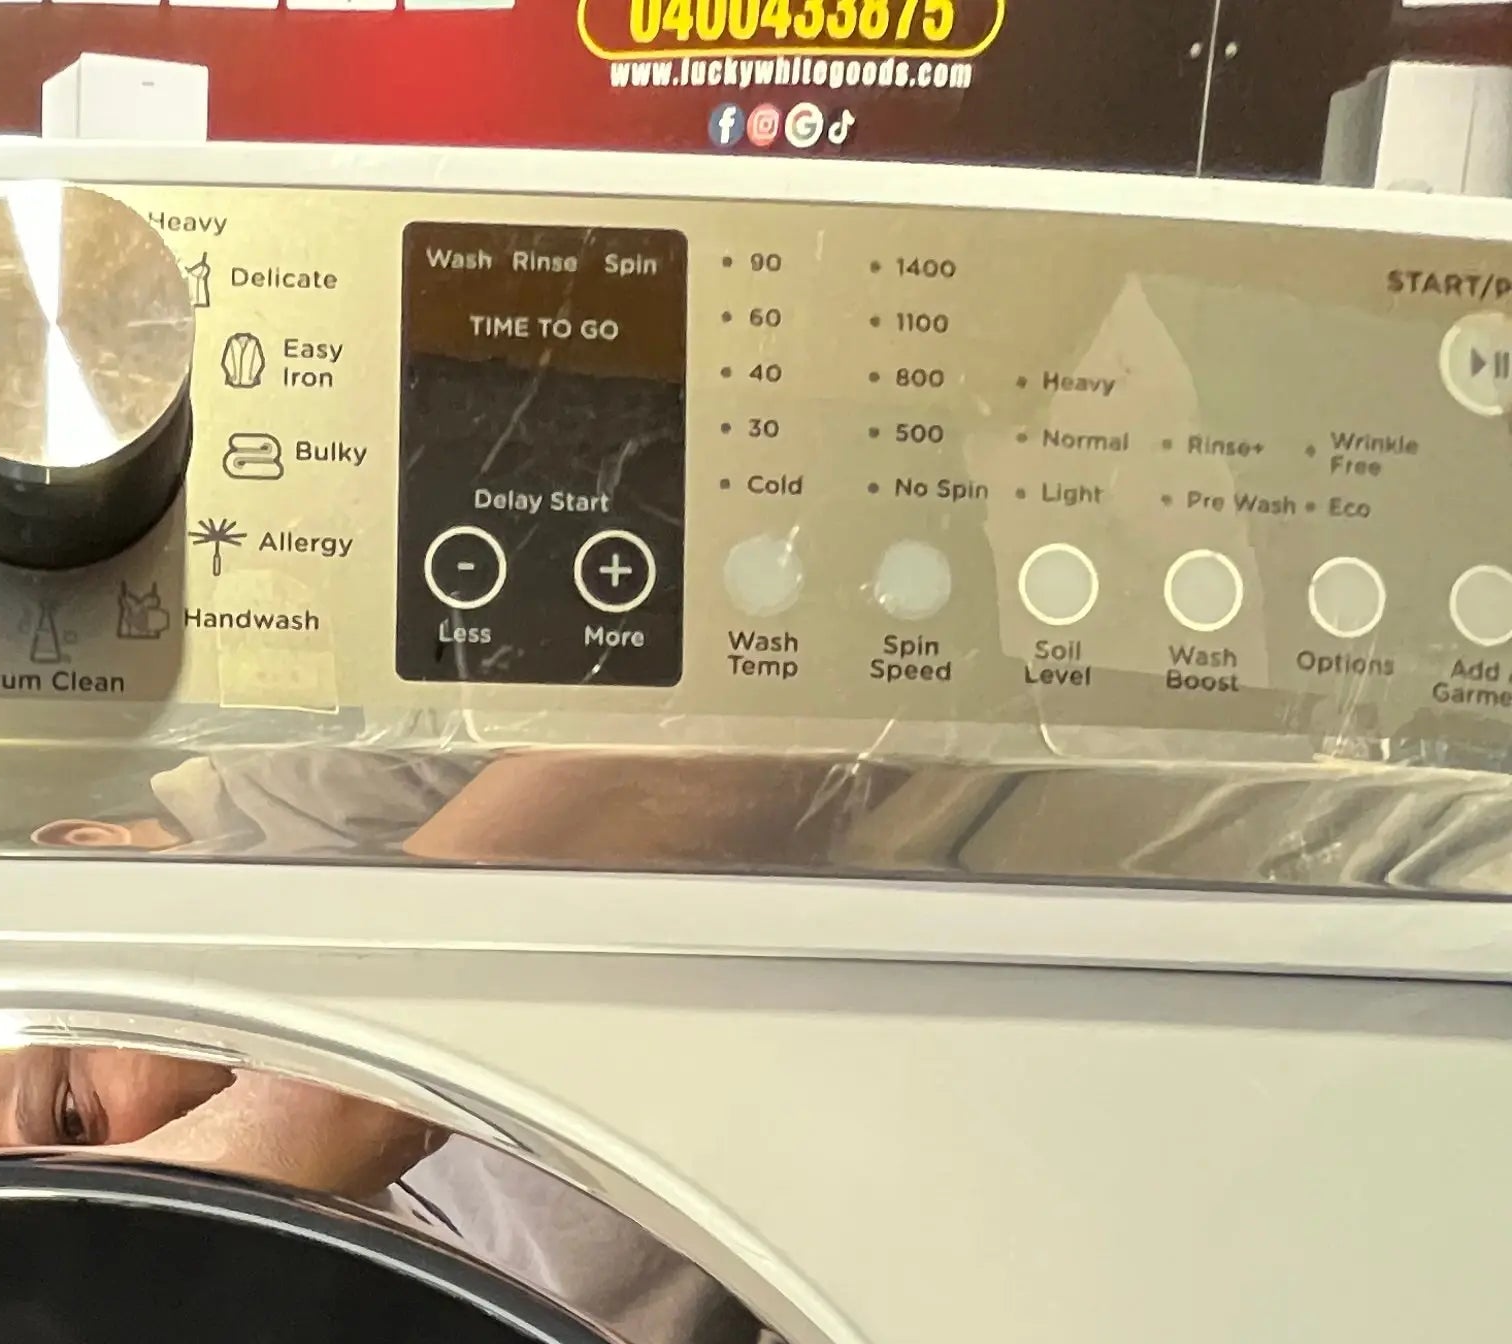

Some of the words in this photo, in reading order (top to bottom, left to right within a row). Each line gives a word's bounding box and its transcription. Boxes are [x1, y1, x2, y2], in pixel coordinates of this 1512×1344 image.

[610, 57, 974, 89] www.luckywhitegoods.com
[149, 212, 228, 236] Heavy
[426, 248, 493, 269] Wash
[512, 251, 579, 273] Rinse
[604, 253, 658, 278] Spin
[749, 252, 783, 273] 90
[895, 256, 957, 279] 1400
[231, 267, 338, 290] Delicate
[469, 314, 530, 339] TIME
[538, 318, 573, 339] TO
[580, 319, 620, 341] GO
[748, 307, 782, 328] 60
[895, 311, 950, 334] 1100
[284, 337, 344, 363] Easy
[283, 366, 334, 388] Iron
[748, 363, 783, 383] 40
[895, 367, 945, 388] 800
[1042, 370, 1117, 397] Heavy
[748, 418, 781, 439] 30
[895, 423, 945, 444] 500
[1041, 428, 1130, 452] Normal
[295, 440, 368, 467] Bulky
[1187, 434, 1265, 458] Rinse+
[1330, 430, 1420, 456] Wrinkle
[1329, 454, 1382, 477] Free
[746, 474, 804, 496] Cold
[894, 477, 929, 498] No
[936, 478, 989, 503] Spin
[1041, 482, 1106, 507] Light
[474, 488, 544, 515] Delay
[549, 491, 611, 514] Start
[1186, 489, 1226, 513] Pre
[1233, 491, 1297, 516] Wash
[1328, 496, 1372, 519] Eco
[258, 531, 354, 558] Allergy
[183, 607, 321, 631] Handwash
[438, 620, 492, 645] Less
[584, 625, 646, 649] More
[727, 630, 800, 653] Wash
[882, 634, 941, 659] Spin
[1034, 639, 1082, 662] Soil
[1168, 644, 1239, 668] Wash
[727, 654, 800, 680] Temp
[869, 659, 953, 683] Speed
[1024, 665, 1092, 687] Level
[1296, 650, 1396, 678] Options
[1449, 657, 1501, 683] Add
[51, 669, 125, 694] Clean
[1166, 668, 1240, 693] Boost
